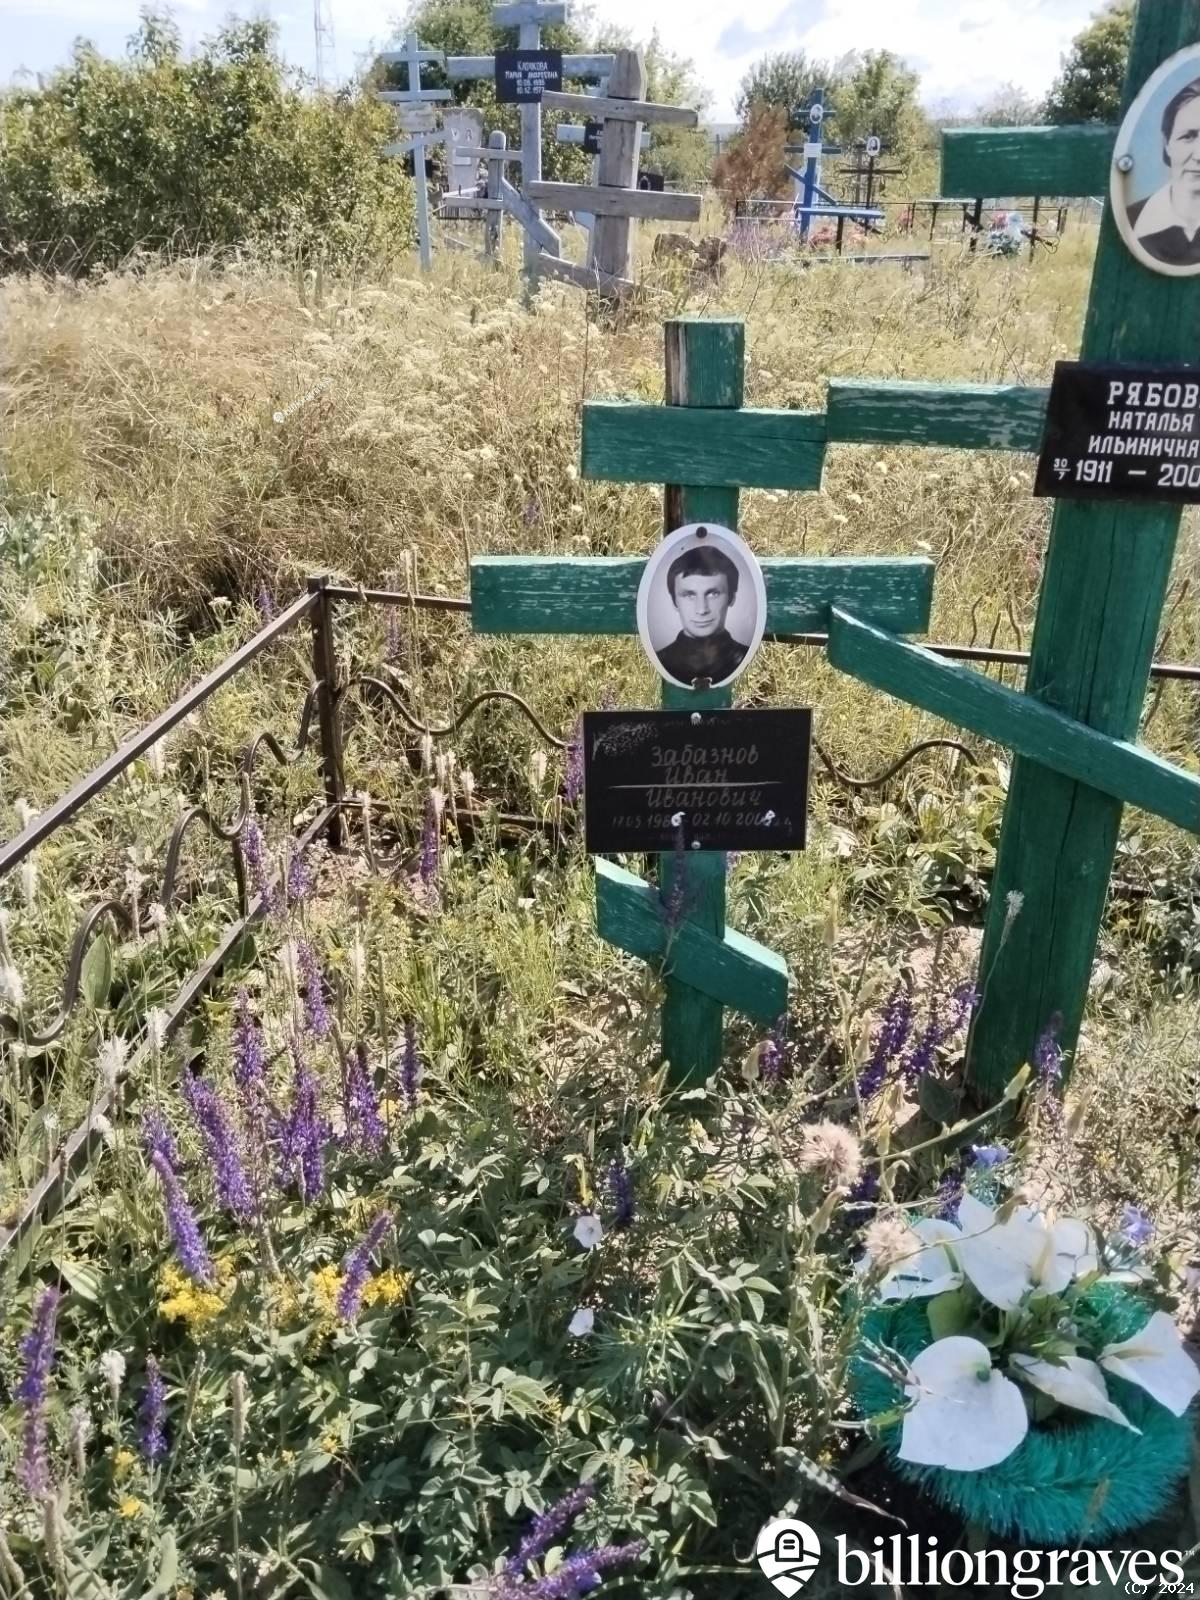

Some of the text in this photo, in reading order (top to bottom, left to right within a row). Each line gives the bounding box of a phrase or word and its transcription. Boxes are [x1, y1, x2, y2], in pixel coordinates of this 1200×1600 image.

[1107, 381, 1200, 408] РЯБОВ
[1108, 411, 1195, 432] НАТАЛЬЯ
[1088, 435, 1200, 458] ИЛЬИНИЧНА
[1075, 459, 1113, 483] 1911
[651, 744, 758, 767] Забазнов
[665, 766, 729, 785] Иван
[645, 787, 761, 807] Иванович
